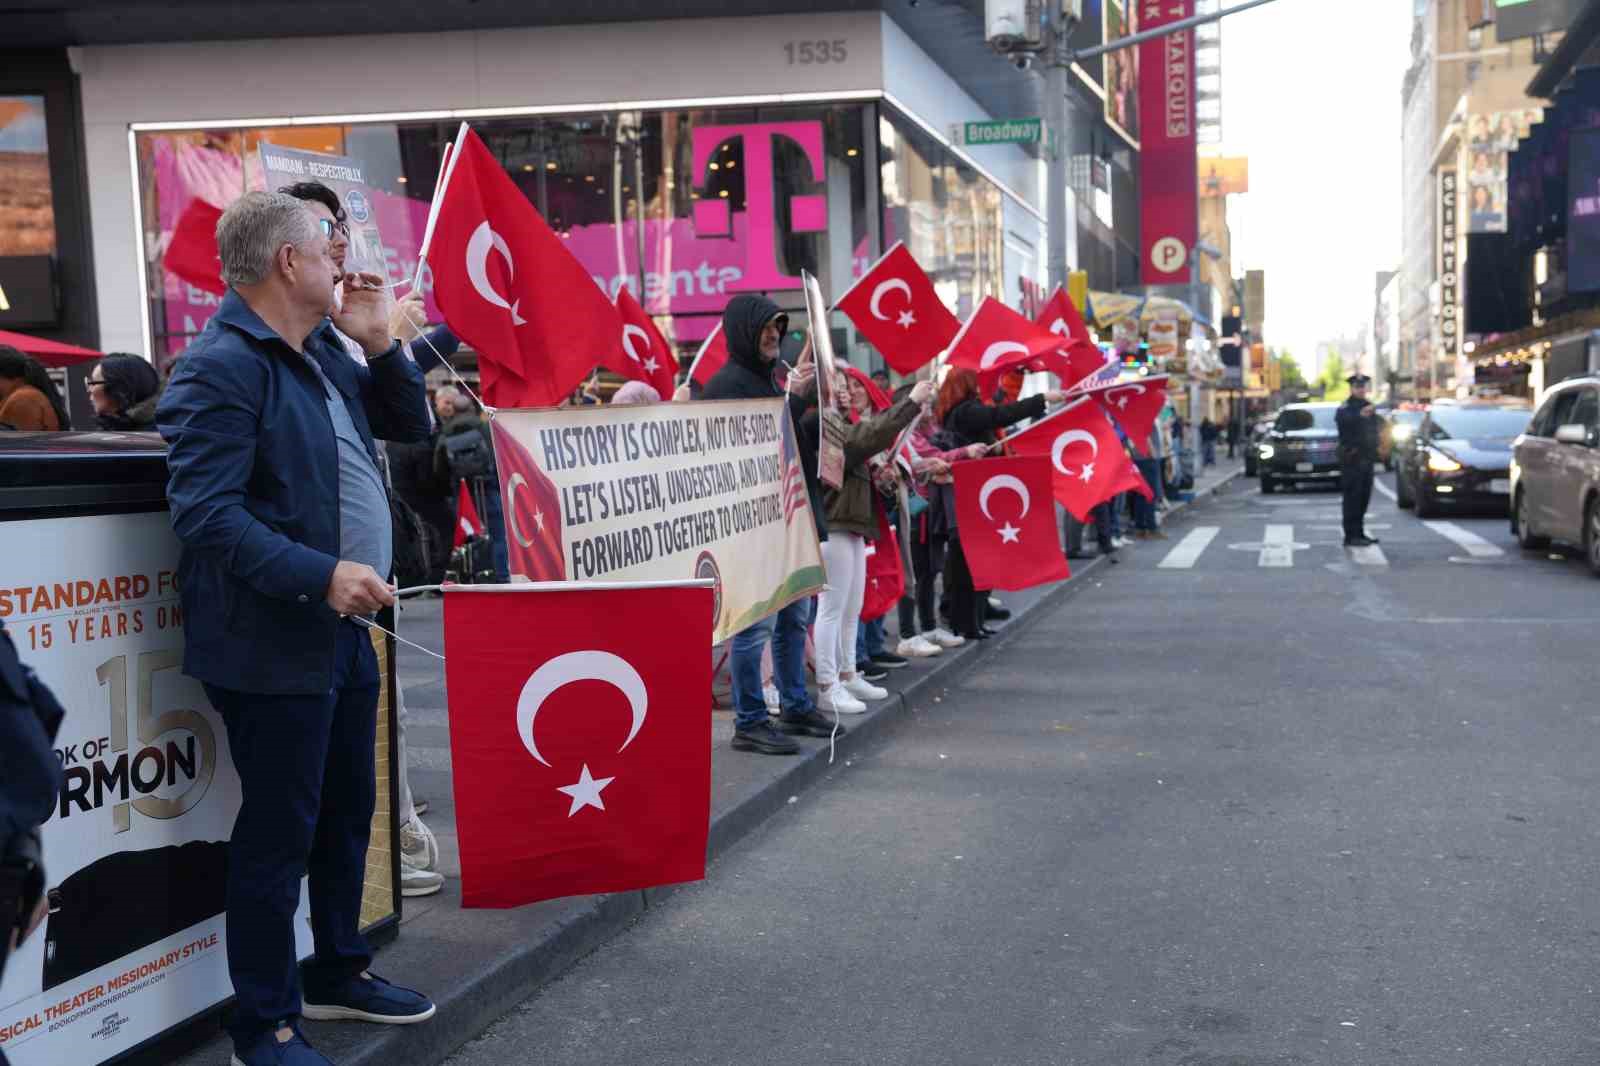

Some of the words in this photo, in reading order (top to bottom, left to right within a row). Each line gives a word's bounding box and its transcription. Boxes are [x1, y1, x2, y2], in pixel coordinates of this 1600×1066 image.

[783, 40, 848, 65] 1535
[968, 123, 1039, 142] Broadway
[1443, 175, 1457, 351] SCIENTOLOGY
[540, 423, 619, 471] HISTORY
[621, 422, 640, 461] IS
[641, 417, 705, 458] COMPLEX,
[705, 416, 728, 450] NOT
[728, 413, 781, 447] ONE-SIDED.
[563, 480, 609, 526] LET'S
[610, 472, 666, 516] LISTEN,
[665, 461, 741, 505] UNDERSTAND,
[738, 457, 758, 489] AND
[757, 453, 781, 483] MOVE
[571, 525, 653, 580] FORWARD
[654, 509, 717, 557] TOGETHER
[717, 506, 731, 540] TO
[731, 499, 755, 534] OUR
[0, 574, 149, 617] STANDARD
[28, 623, 53, 650] 15
[68, 609, 144, 644] YEARS
[82, 737, 109, 760] OF
[44, 735, 196, 826] RMON
[107, 950, 180, 993] MISSIONARY
